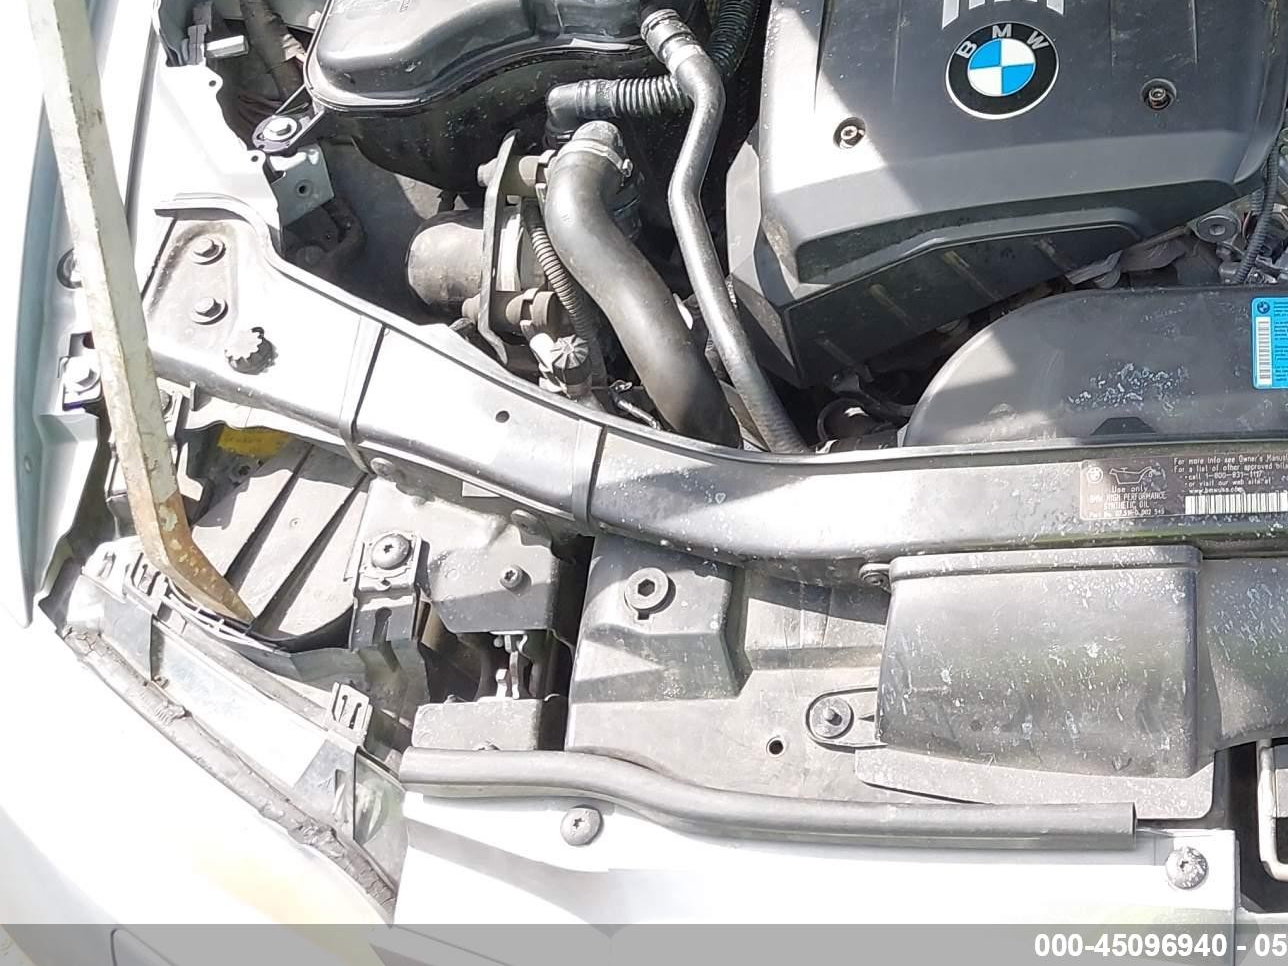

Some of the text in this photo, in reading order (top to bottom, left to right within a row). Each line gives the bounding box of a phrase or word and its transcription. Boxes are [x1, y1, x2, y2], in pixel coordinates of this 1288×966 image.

[956, 23, 1050, 59] BMW
[1173, 457, 1185, 465] For
[1188, 457, 1204, 465] more
[1207, 456, 1221, 464] info
[1239, 454, 1263, 463] Owner's
[1266, 453, 1288, 463] Manual
[1173, 465, 1185, 473] For
[1196, 465, 1208, 473] list
[1222, 463, 1240, 472] other
[1243, 463, 1273, 472] approved
[1188, 472, 1201, 481] call
[1199, 478, 1215, 487] visit
[1232, 478, 1245, 486] web
[1111, 484, 1149, 495] Use only
[1106, 493, 1121, 501] HIGH
[1123, 491, 1168, 501] PERFORMANCE
[1139, 500, 1150, 508] OIL
